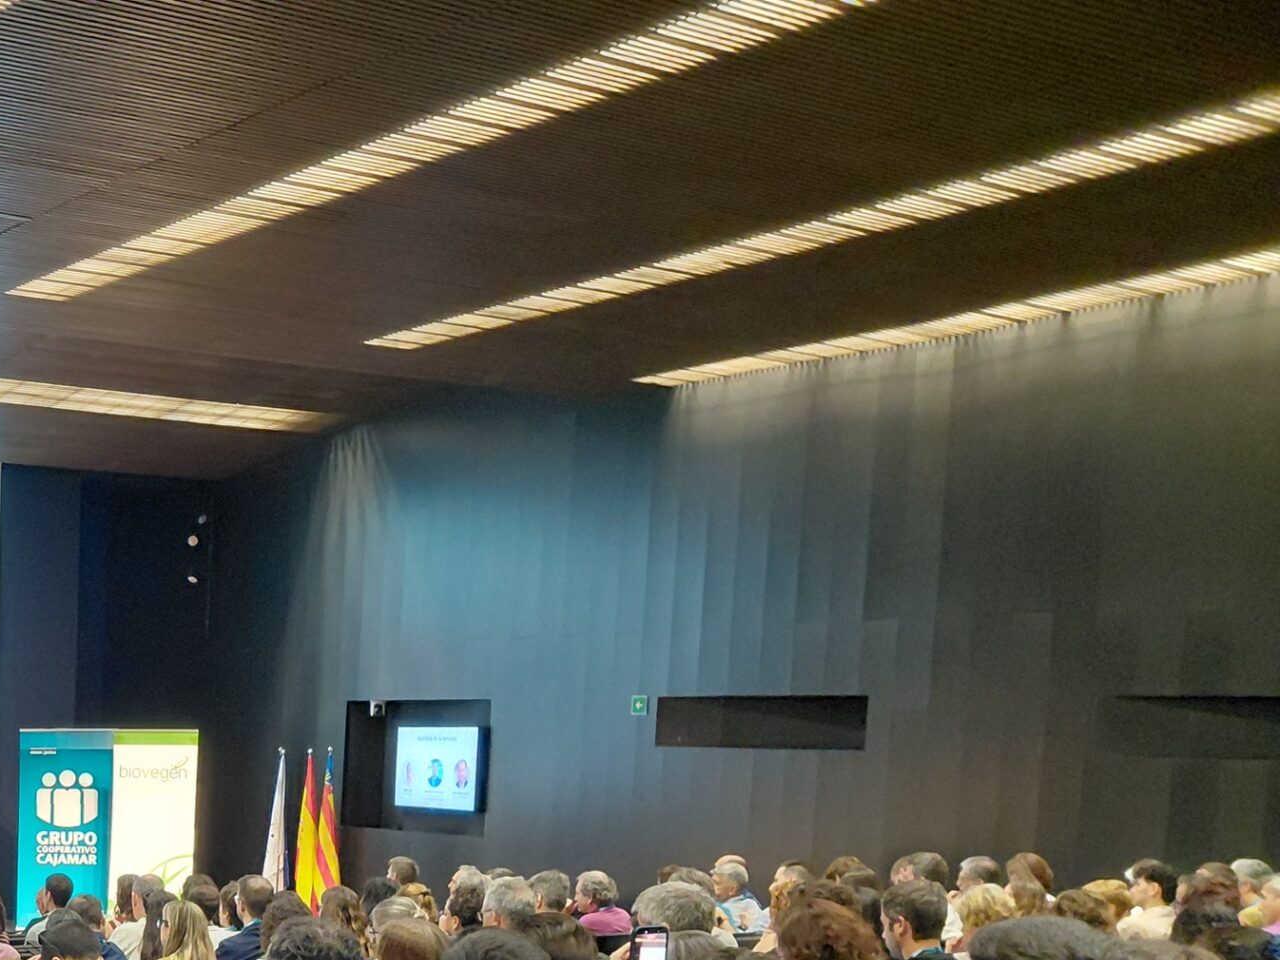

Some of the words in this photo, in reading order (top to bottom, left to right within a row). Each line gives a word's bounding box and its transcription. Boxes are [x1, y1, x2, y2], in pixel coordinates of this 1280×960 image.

[119, 764, 188, 782] biovegen
[36, 831, 97, 846] GRUPO
[36, 845, 97, 854] COOPERATIVO
[36, 853, 97, 866] CAJAMAR
